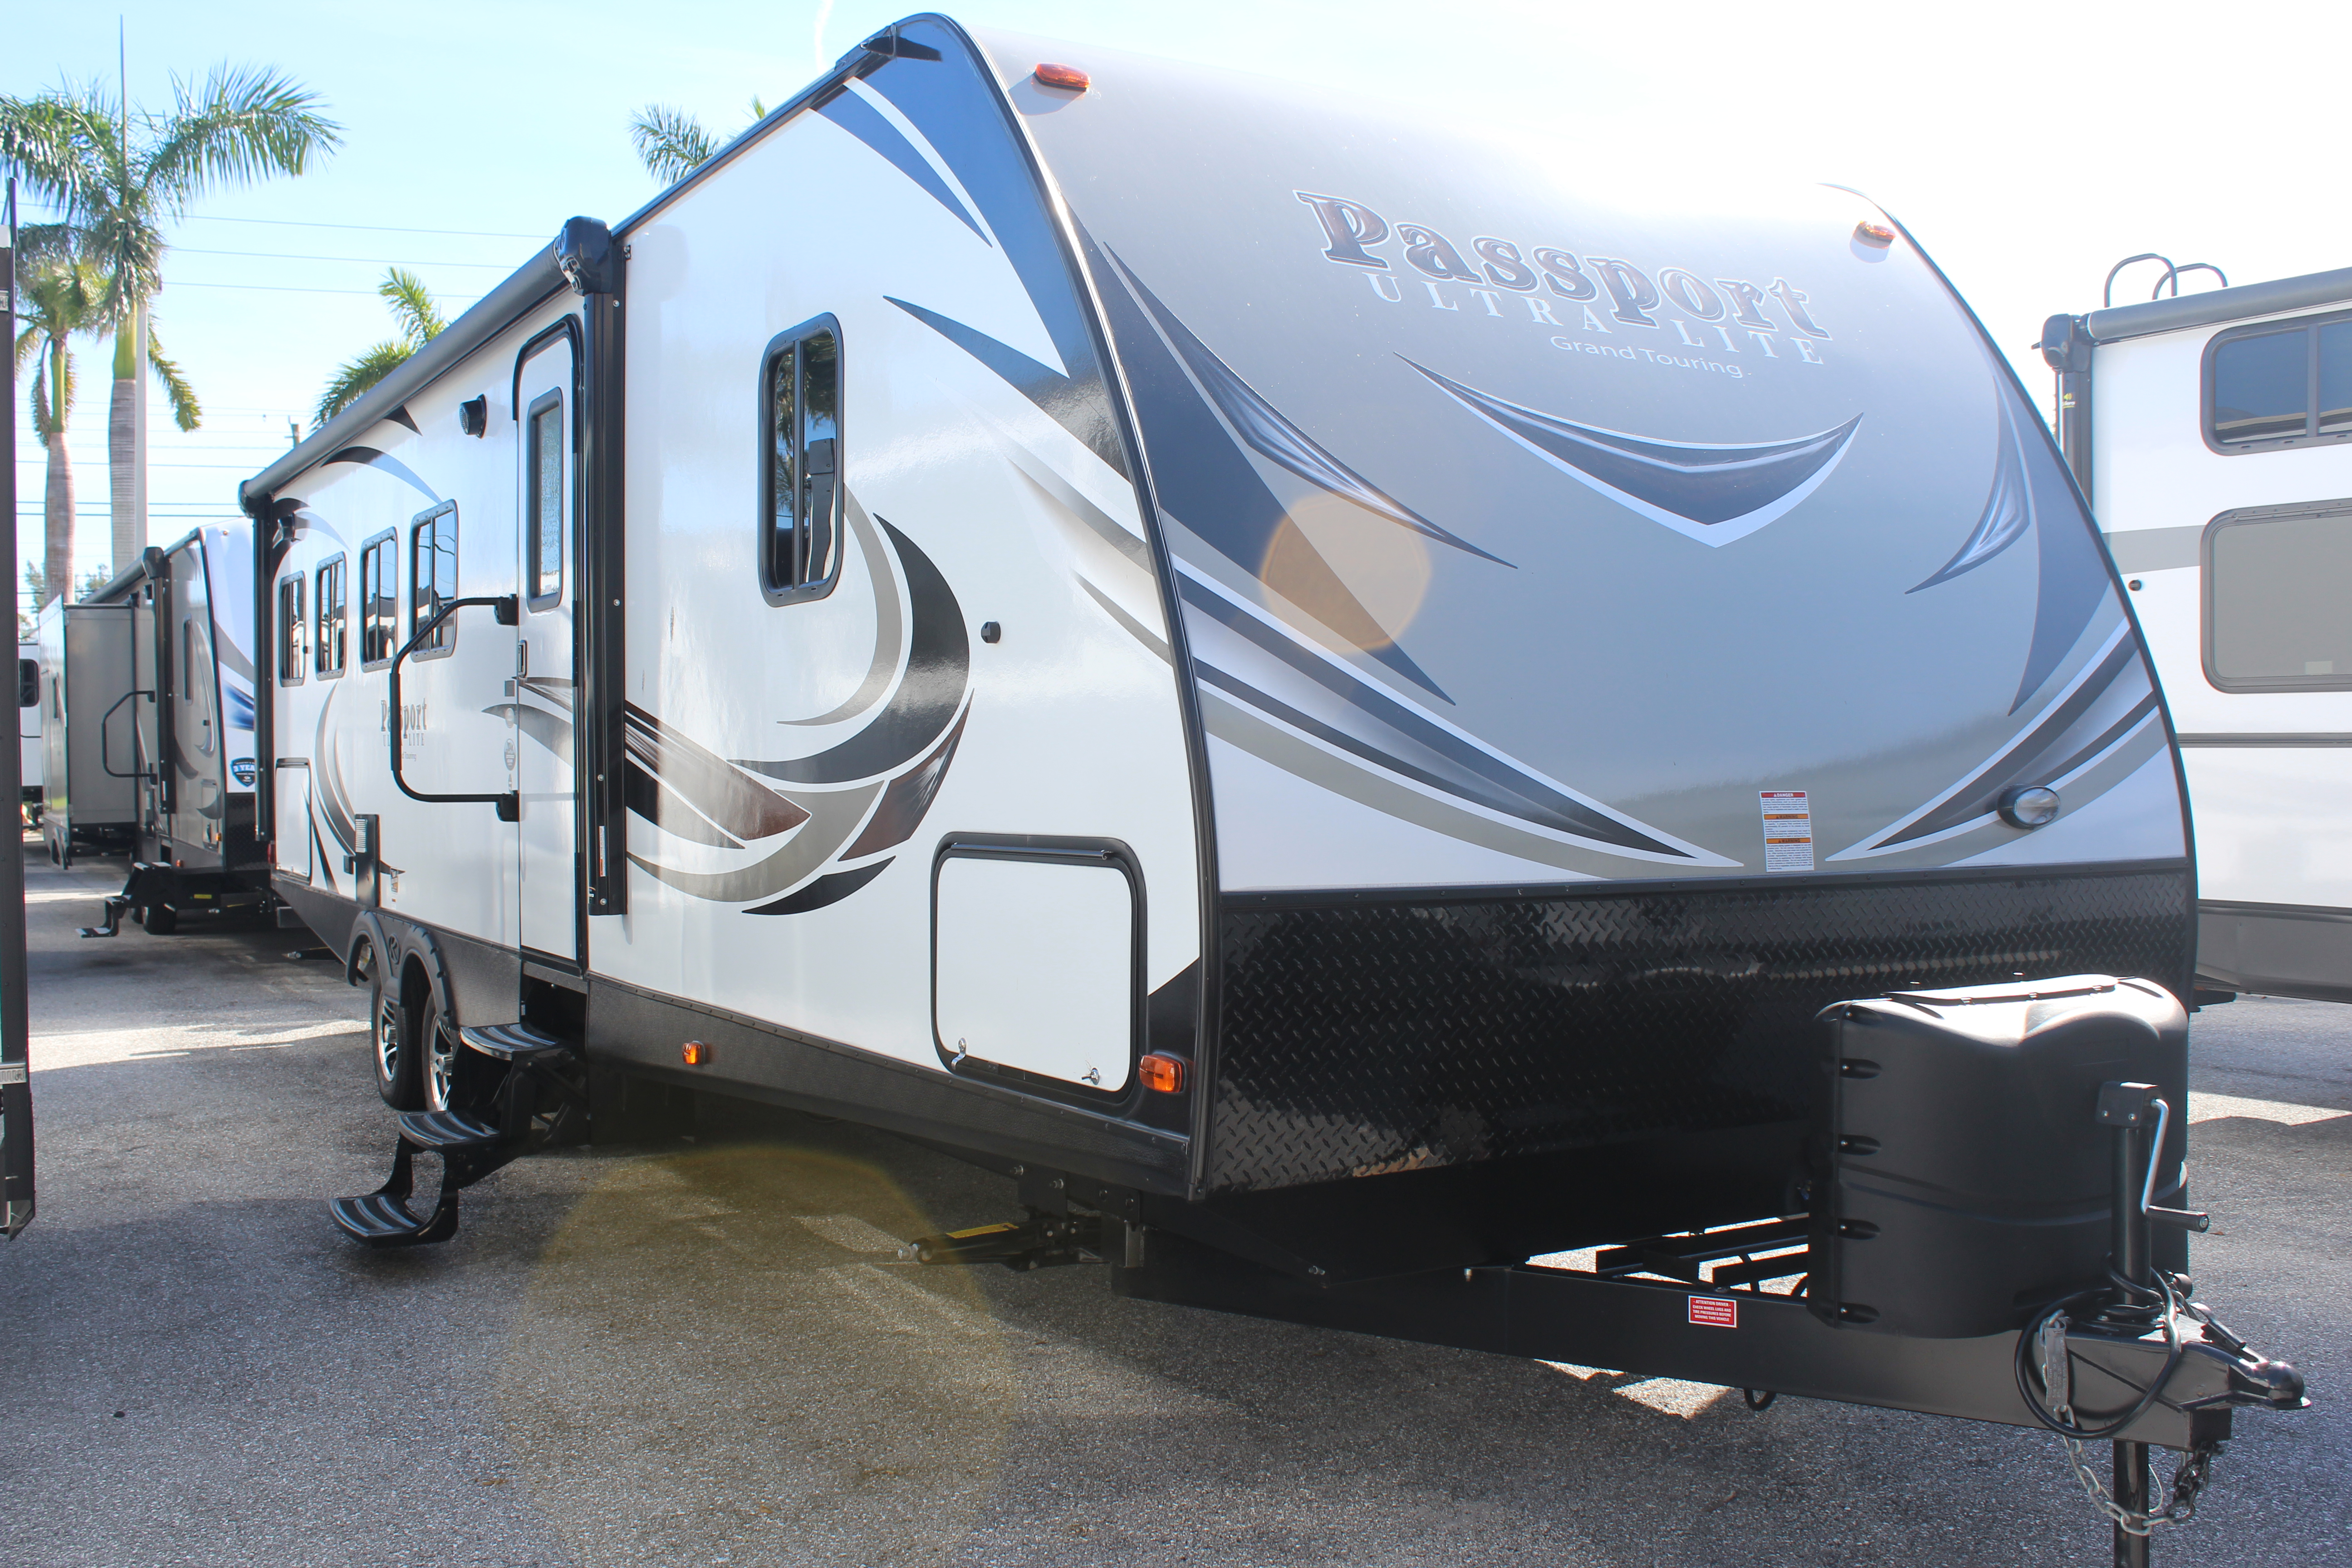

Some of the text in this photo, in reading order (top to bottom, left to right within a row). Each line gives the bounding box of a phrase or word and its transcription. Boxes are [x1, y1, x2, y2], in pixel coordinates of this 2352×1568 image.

[1293, 190, 1833, 342] Passport
[1362, 272, 1823, 364] ULTRA LITE
[1551, 336, 1744, 378] Grand Touring
[409, 733, 424, 746] LITE
